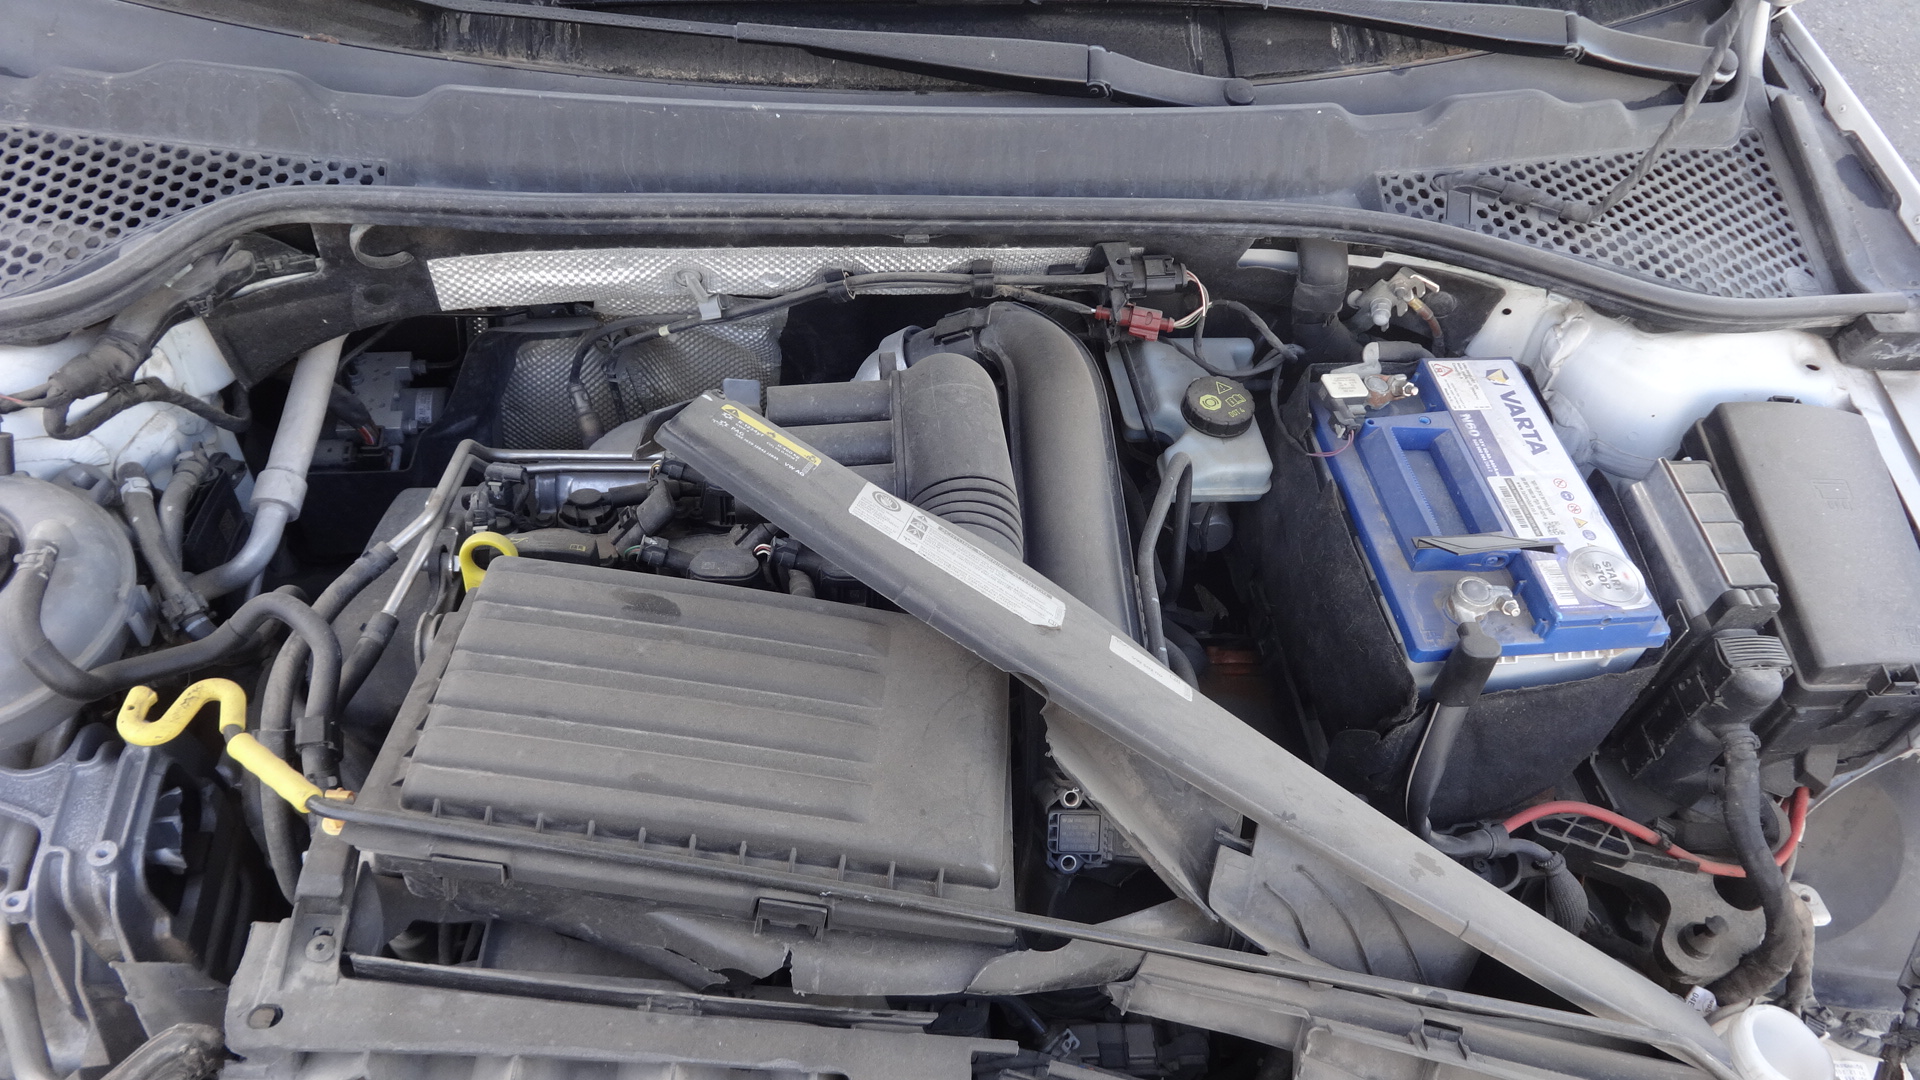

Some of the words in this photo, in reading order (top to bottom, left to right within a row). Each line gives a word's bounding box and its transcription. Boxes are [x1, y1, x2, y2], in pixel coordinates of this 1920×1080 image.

[1228, 408, 1240, 418] DOT
[1460, 413, 1480, 437] N60
[1500, 390, 1548, 456] VARTA
[730, 426, 744, 436] PAG
[784, 462, 795, 470] VW
[1592, 563, 1612, 590] STOP
[1602, 560, 1624, 590] START
